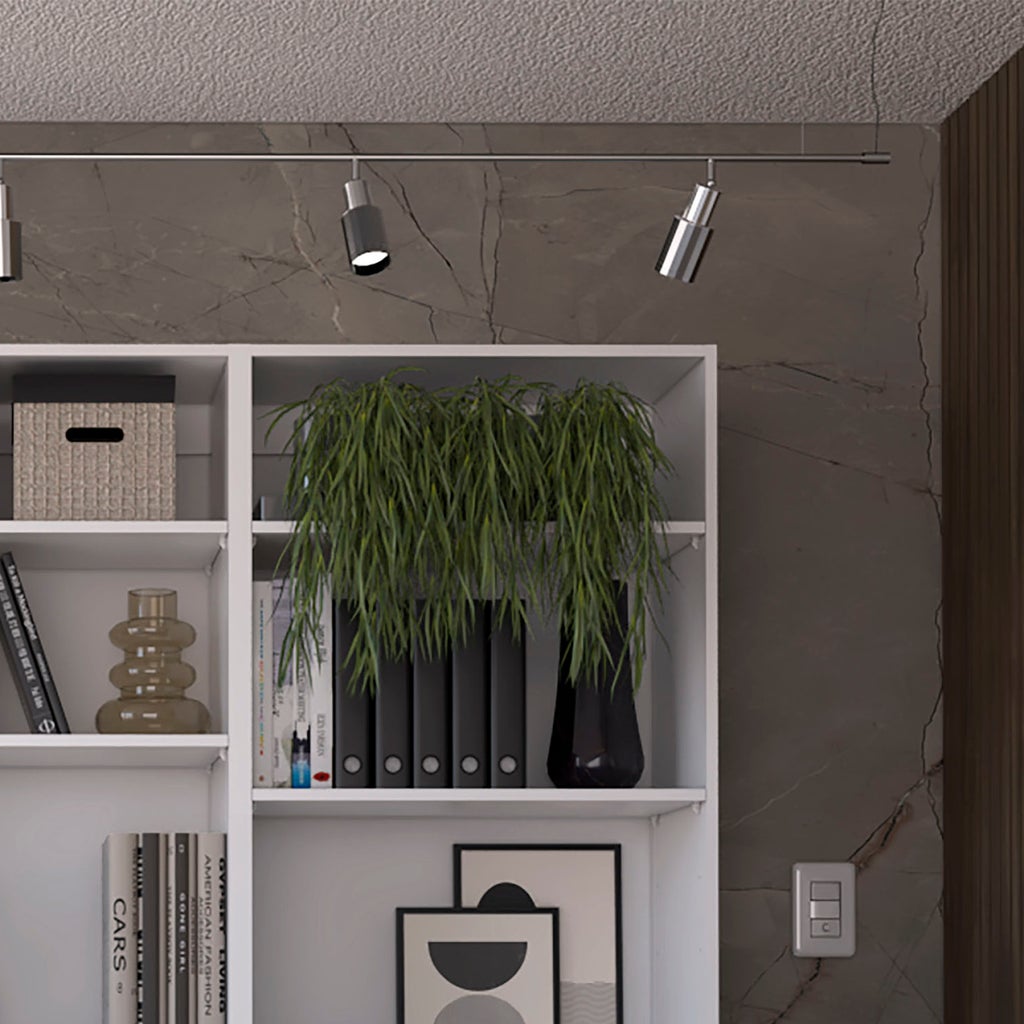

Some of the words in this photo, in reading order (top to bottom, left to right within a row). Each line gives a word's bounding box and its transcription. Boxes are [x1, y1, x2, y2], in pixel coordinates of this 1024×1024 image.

[204, 855, 212, 940] AMERICAN
[113, 898, 126, 972] CARS
[204, 946, 212, 1016] FASHION
